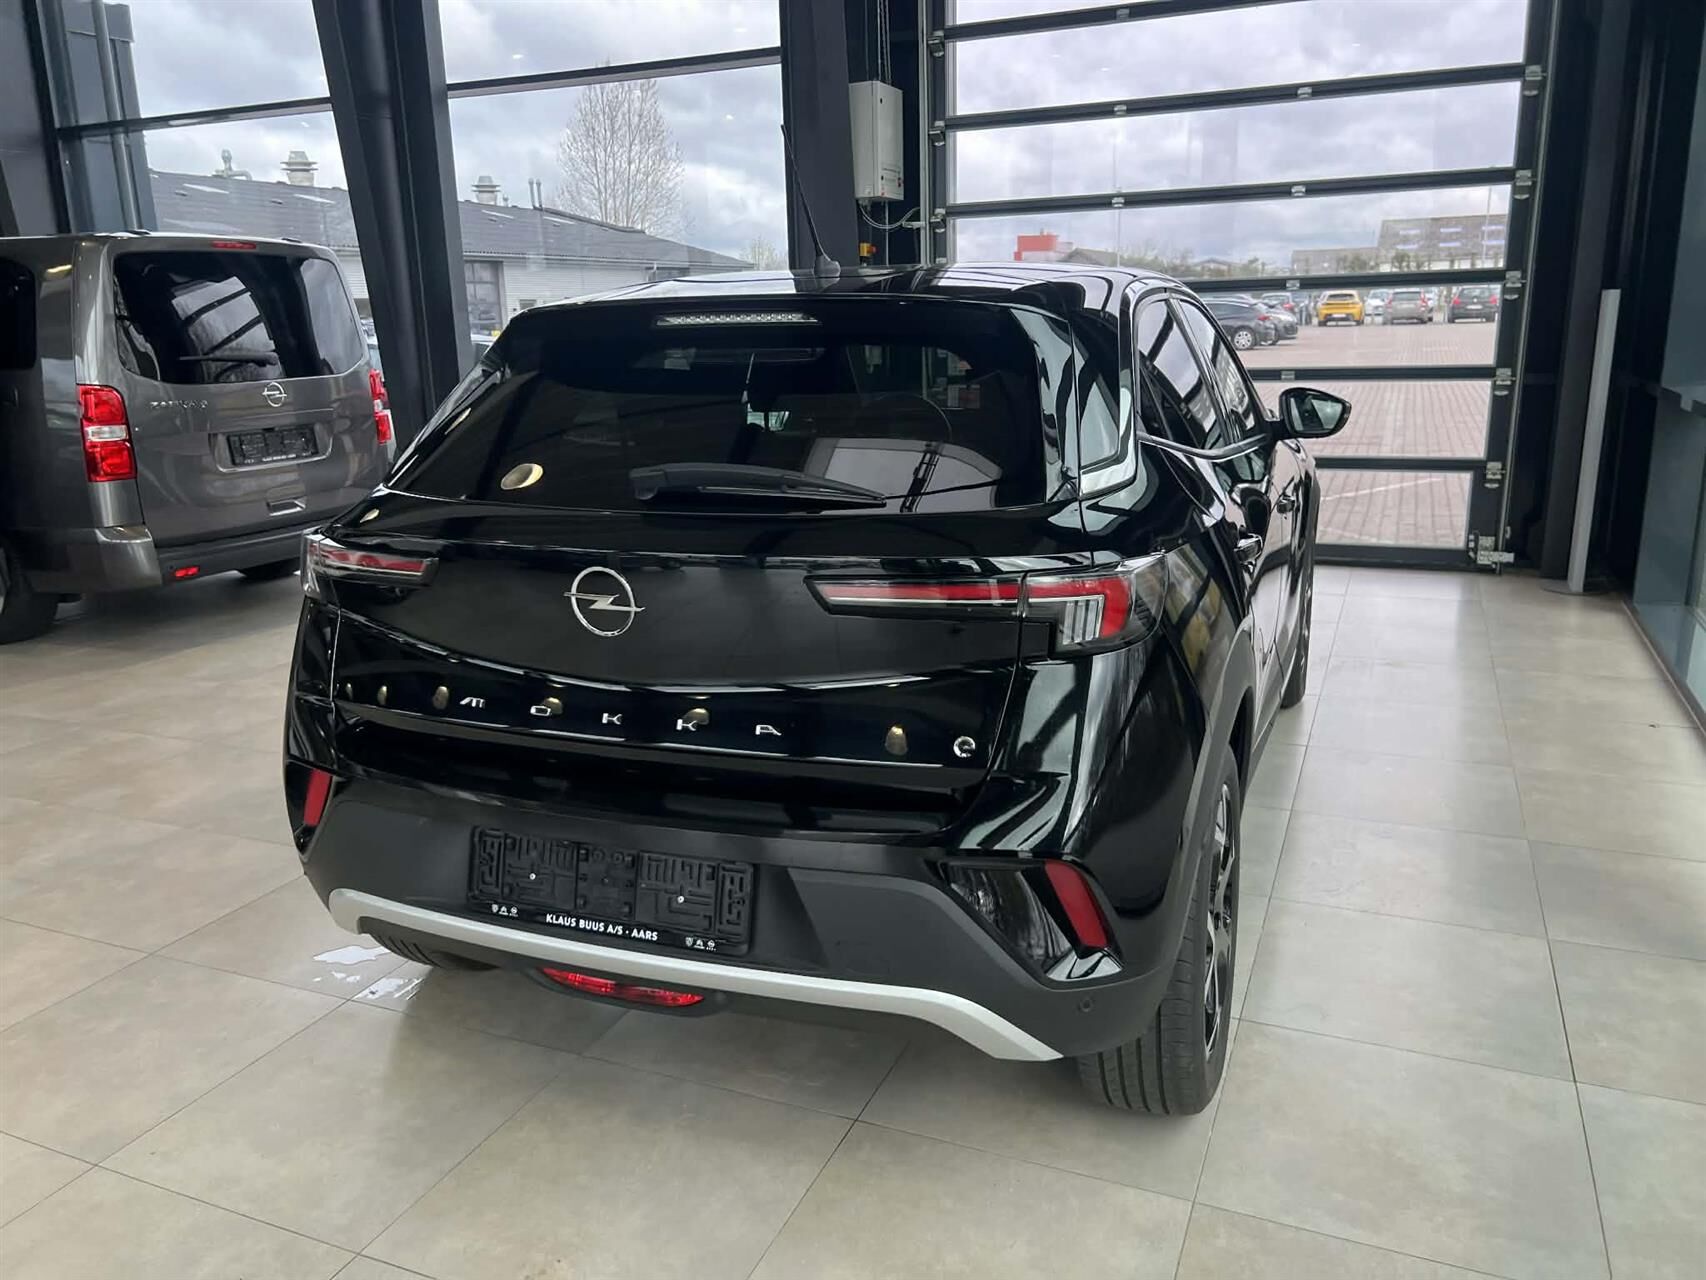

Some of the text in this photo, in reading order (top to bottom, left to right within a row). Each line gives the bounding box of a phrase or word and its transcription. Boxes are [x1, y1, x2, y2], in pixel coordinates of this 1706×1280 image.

[459, 696, 782, 736] MOKKA
[546, 914, 658, 940] KLAUS BUUS A/S AARS
